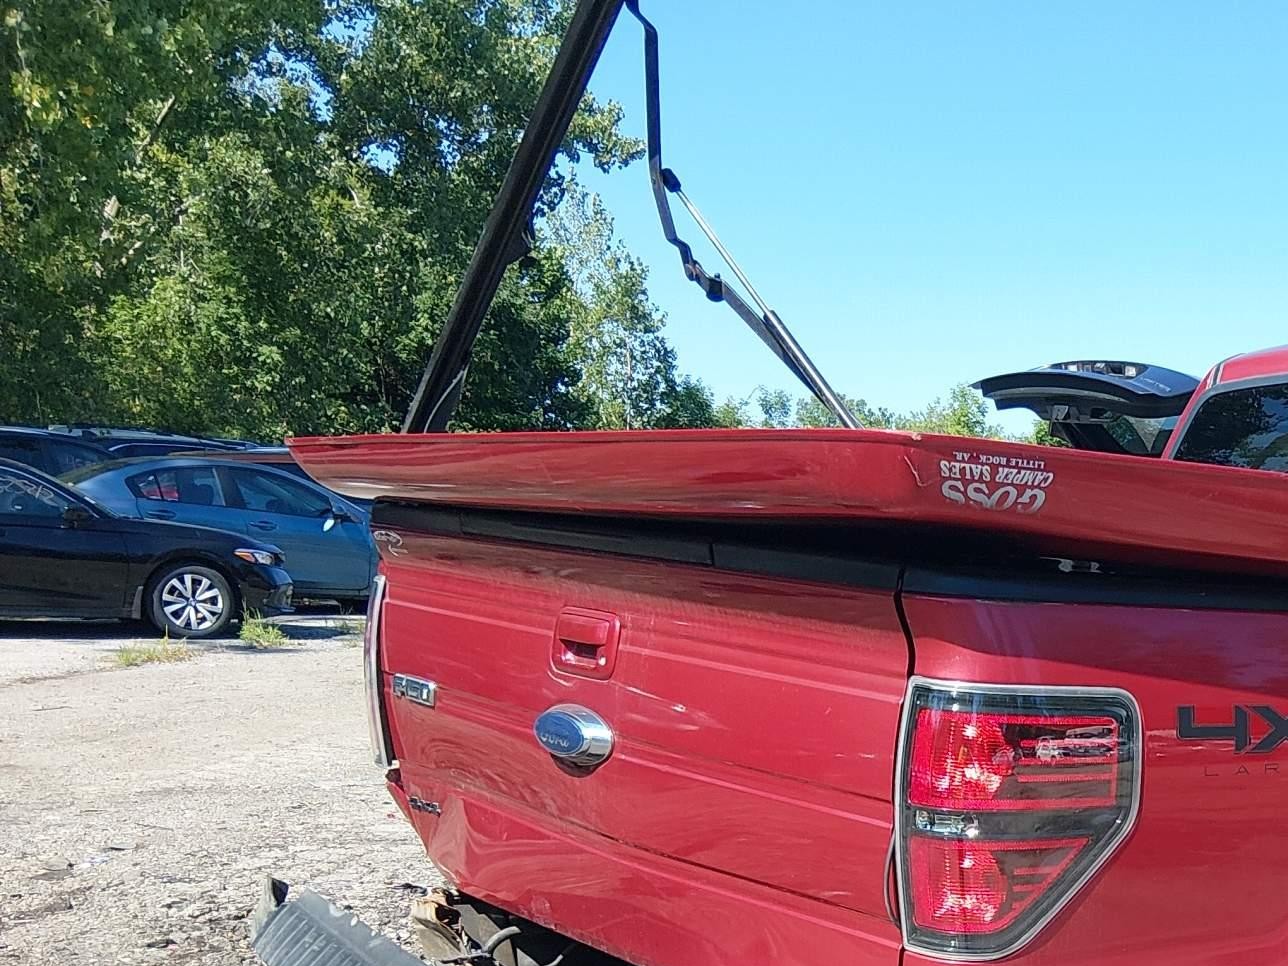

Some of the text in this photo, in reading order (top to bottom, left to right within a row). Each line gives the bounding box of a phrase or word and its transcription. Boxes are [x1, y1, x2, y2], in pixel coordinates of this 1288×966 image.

[940, 460, 1054, 488] CAMPER SALES
[1008, 457, 1045, 469] LITTLE
[941, 480, 1046, 514] GOSS
